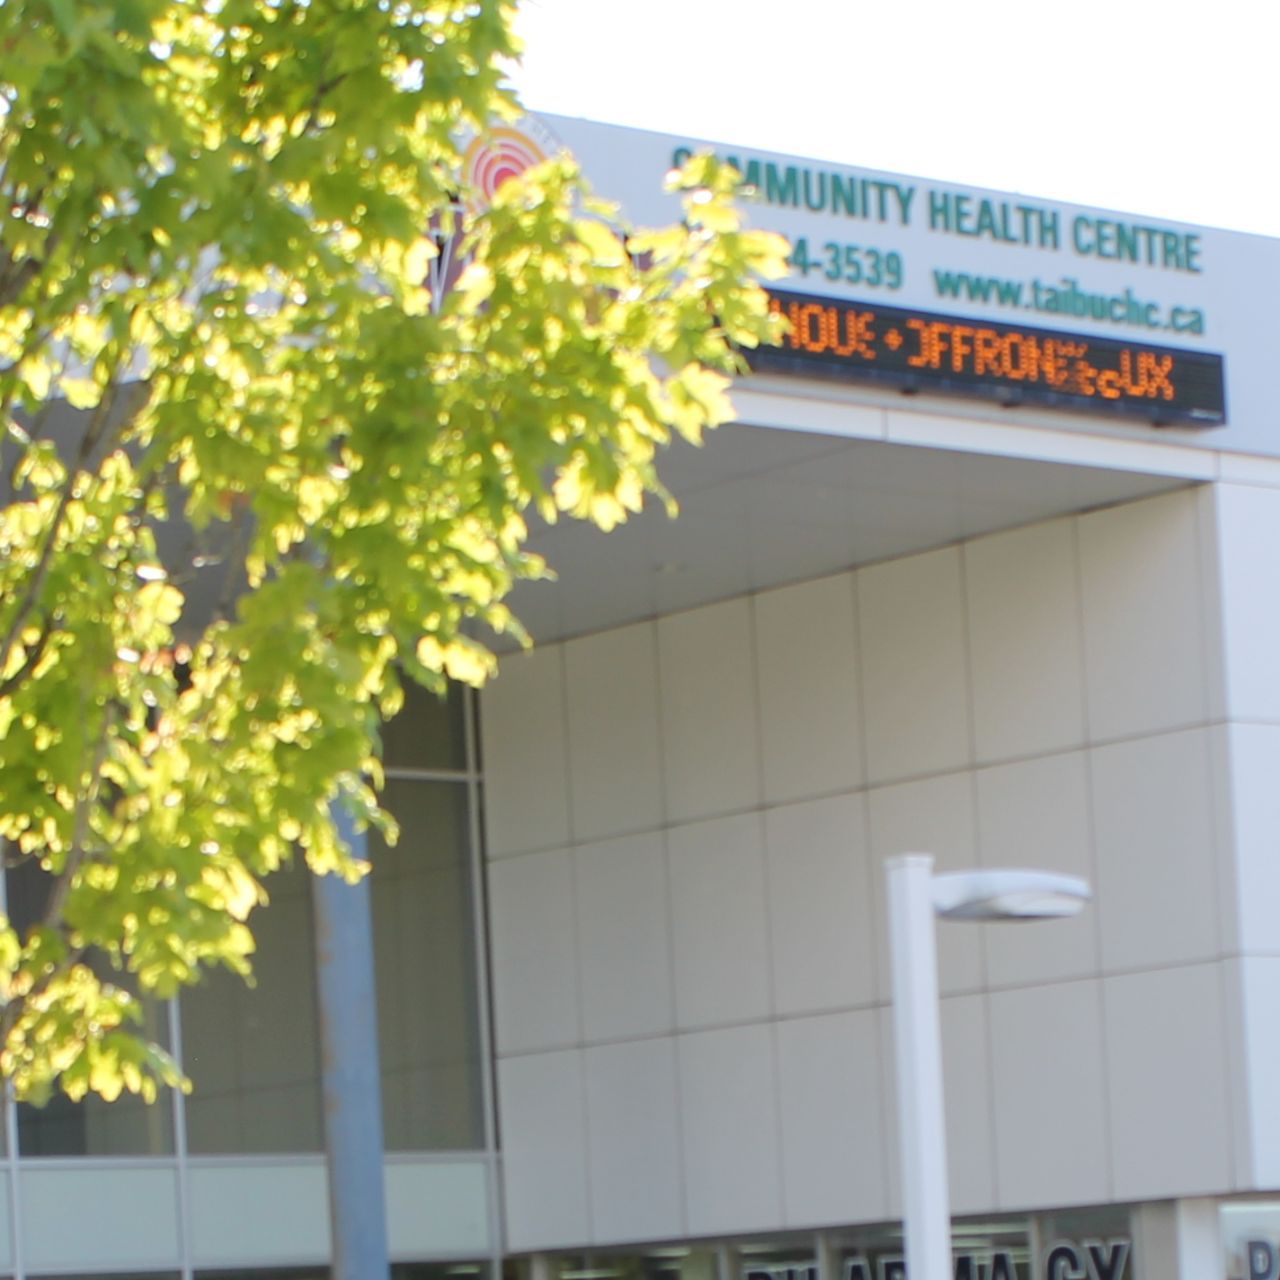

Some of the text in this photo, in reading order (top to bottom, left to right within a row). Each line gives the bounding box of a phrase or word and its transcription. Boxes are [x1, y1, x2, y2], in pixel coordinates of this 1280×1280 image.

[672, 148, 1203, 273] MMUNITY HEALTH CENTRE
